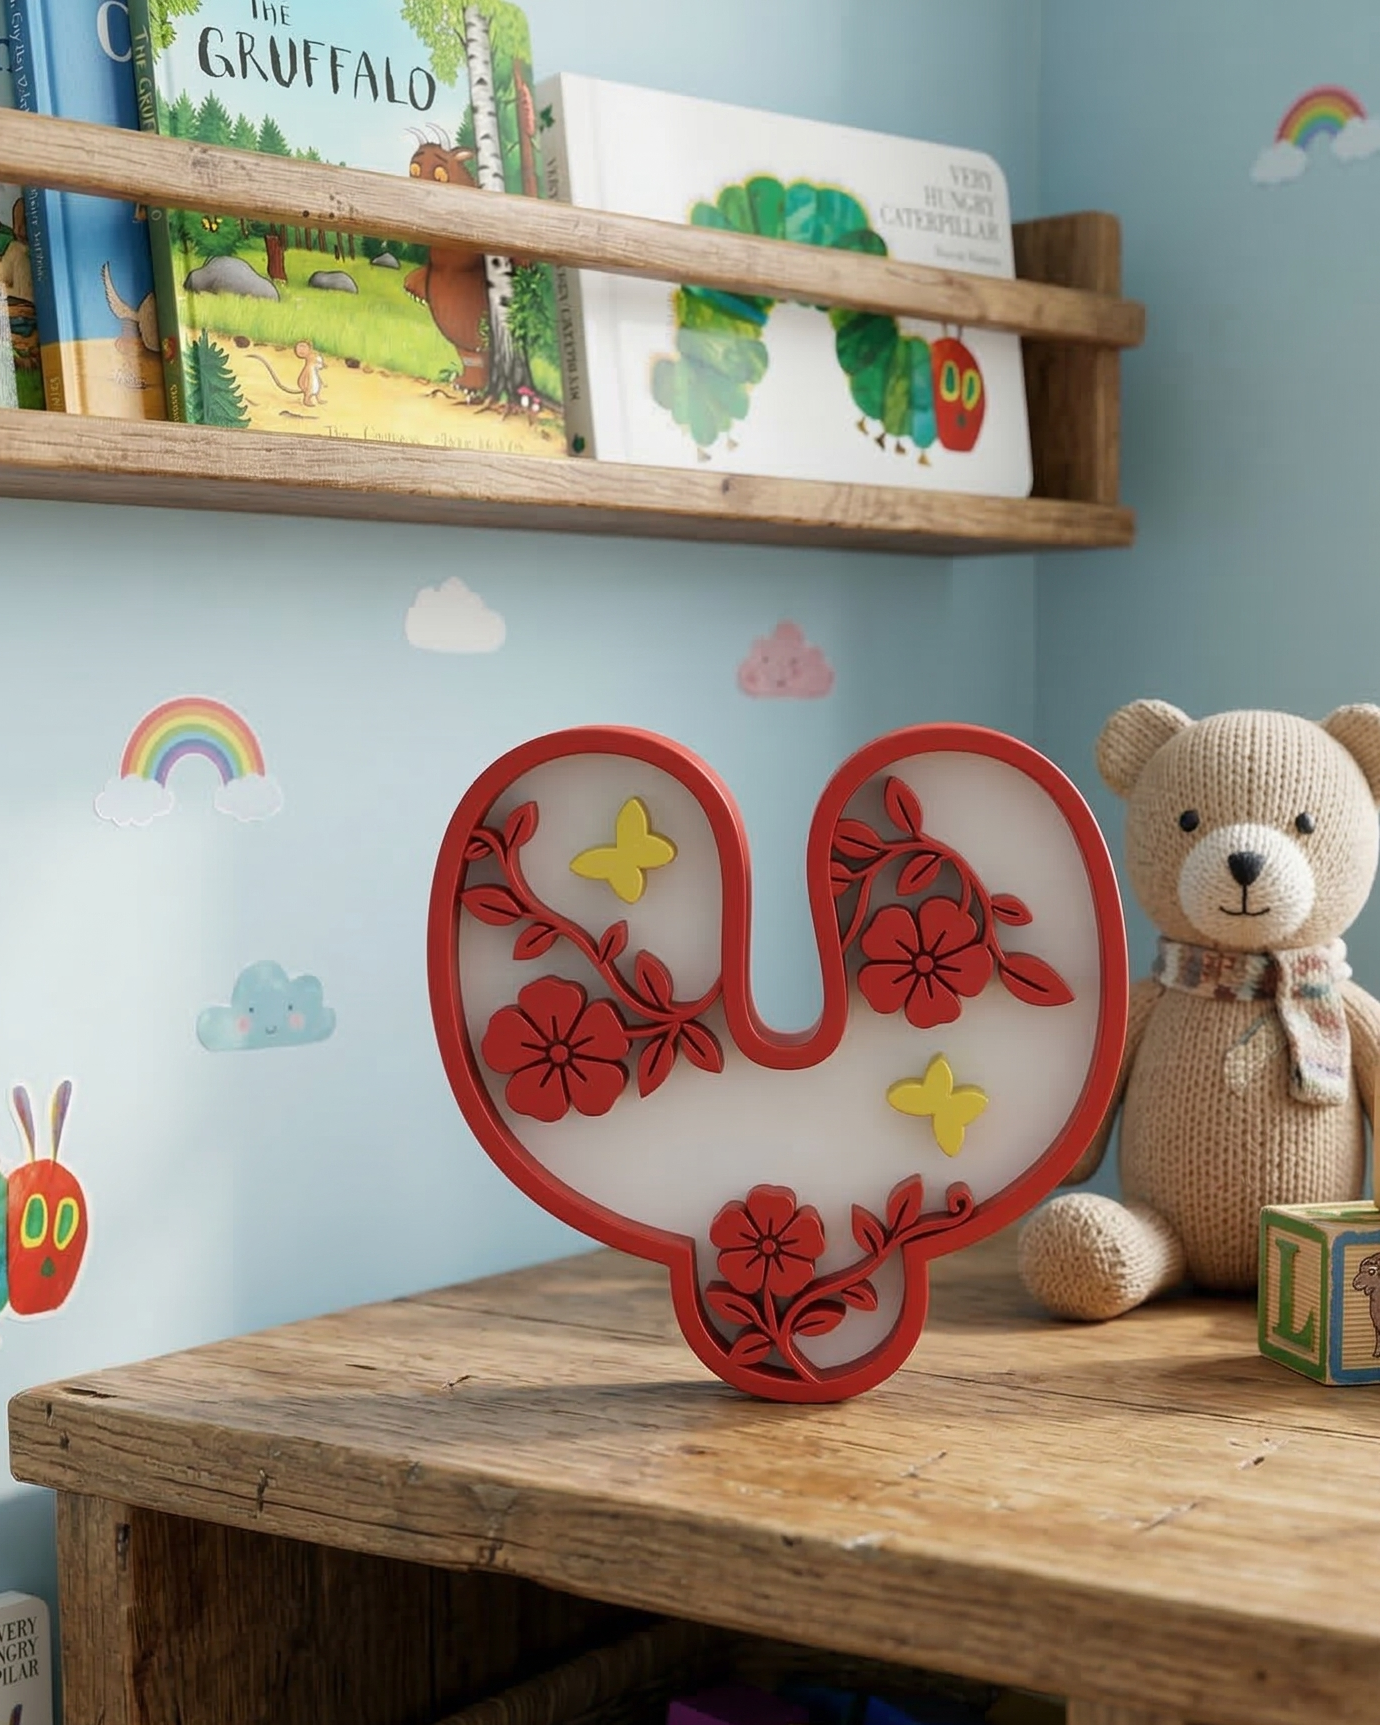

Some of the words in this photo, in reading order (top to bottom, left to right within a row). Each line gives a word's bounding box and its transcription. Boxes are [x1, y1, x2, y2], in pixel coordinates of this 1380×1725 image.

[135, 25, 149, 68] THE
[198, 26, 436, 111] GRUFFALO
[949, 165, 993, 192] VERY
[1272, 1238, 1316, 1352] L
[0, 1616, 38, 1642] VERY
[0, 1658, 40, 1686] ILAR
